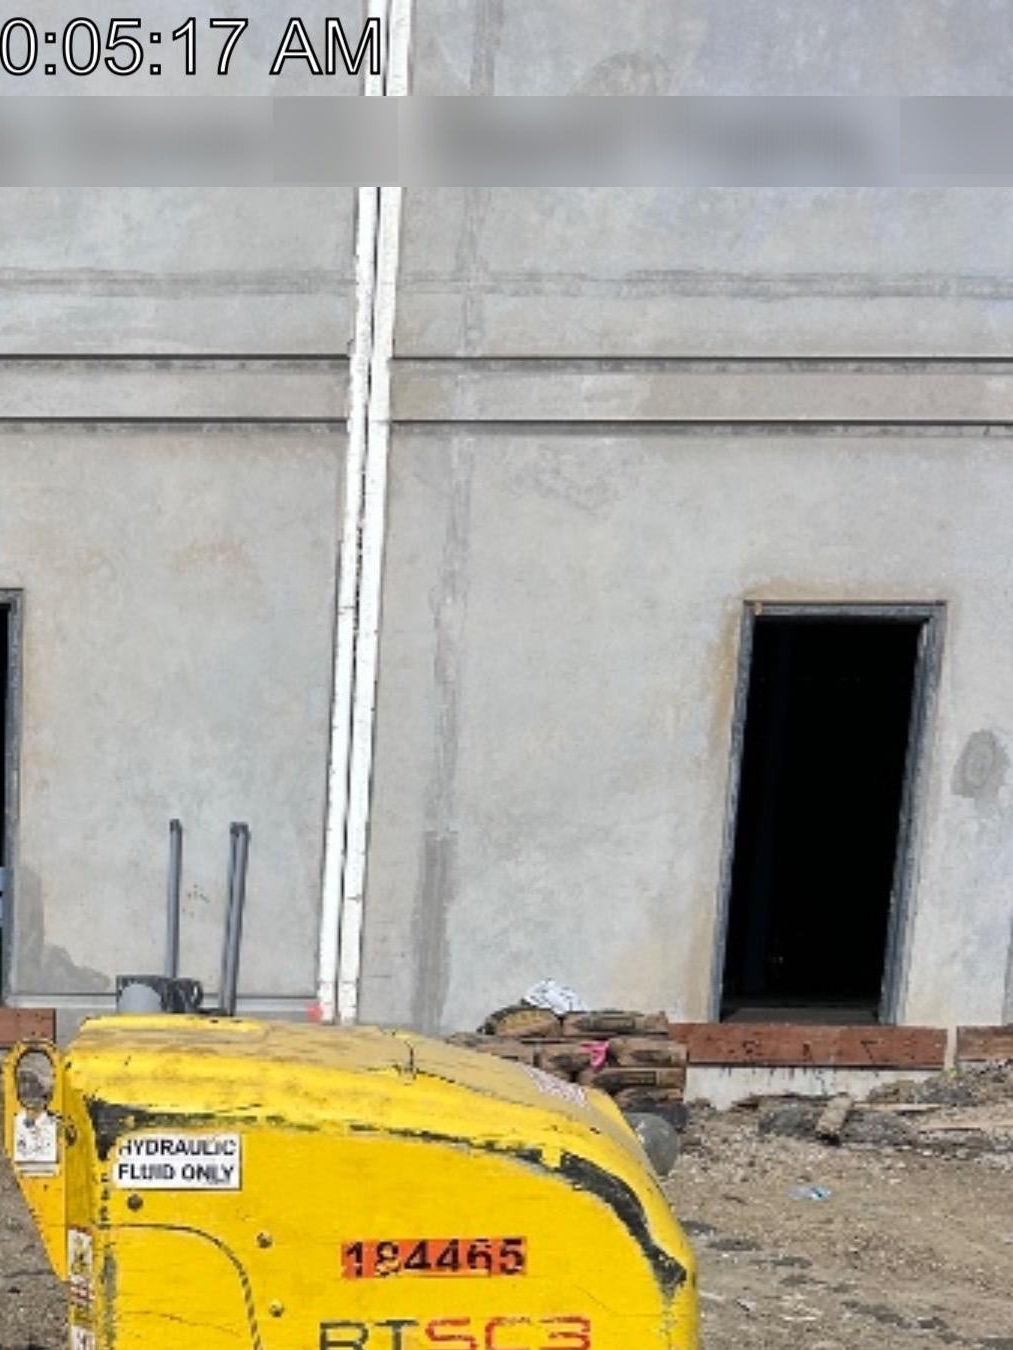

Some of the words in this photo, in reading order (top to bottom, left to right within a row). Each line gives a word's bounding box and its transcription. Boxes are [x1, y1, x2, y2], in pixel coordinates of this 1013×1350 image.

[119, 1139, 237, 1156] HYDRAULIC
[118, 1163, 175, 1180] FLUID
[181, 1163, 234, 1184] ONLY
[345, 1238, 525, 1277] 184465
